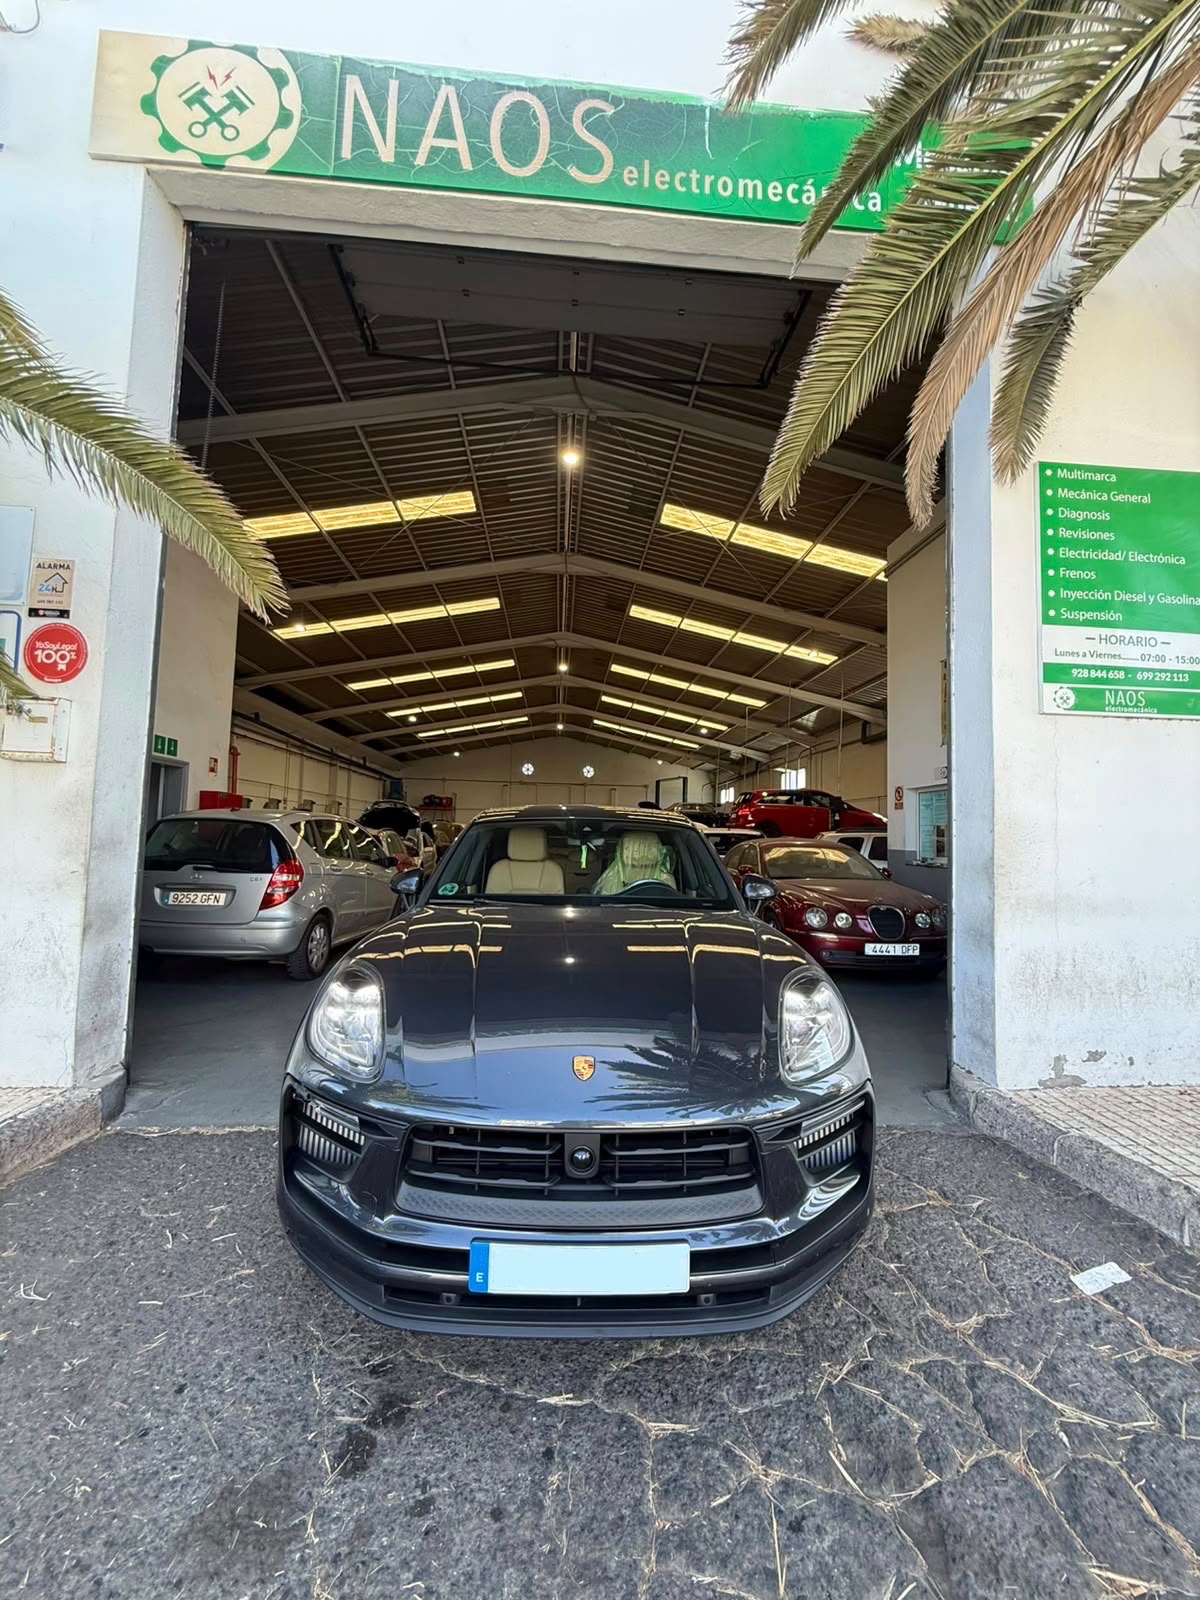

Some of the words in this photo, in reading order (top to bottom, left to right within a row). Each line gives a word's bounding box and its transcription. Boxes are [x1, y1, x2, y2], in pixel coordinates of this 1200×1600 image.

[341, 74, 614, 184] NAOS
[623, 159, 882, 213] electromecáca
[1057, 468, 1117, 482] Multimarca
[1057, 488, 1108, 501] Mecánica
[1110, 491, 1151, 504] General
[1058, 507, 1111, 521] Diagnosis
[1059, 527, 1115, 541] Revisiones
[1059, 547, 1127, 561] Electricidad/
[1128, 551, 1186, 565] Electrónica
[36, 562, 71, 571] ALARMA
[1060, 567, 1097, 580] Frenos
[1060, 587, 1112, 601] Inyección
[1114, 590, 1147, 602] Diesel
[1149, 594, 1154, 605] y
[1157, 592, 1200, 605] Gasolina
[1060, 607, 1123, 622] Suspensión
[1099, 634, 1158, 647] HORARIO
[1055, 648, 1081, 658] Lunes
[1140, 653, 1166, 663] 07:00
[1175, 655, 1200, 665] 15:00
[1071, 668, 1088, 677] 928
[1090, 669, 1107, 678] 844
[1108, 670, 1125, 679] 658
[1136, 671, 1153, 681] 699
[1155, 673, 1171, 681] 292
[1173, 674, 1189, 682] 113
[1105, 689, 1146, 706] NAOS
[1105, 705, 1157, 713] electromecánica
[172, 893, 198, 904] 9252
[200, 894, 221, 904] GFN
[872, 945, 896, 954] 4441
[901, 945, 918, 954] DFP
[476, 1272, 484, 1282] E
